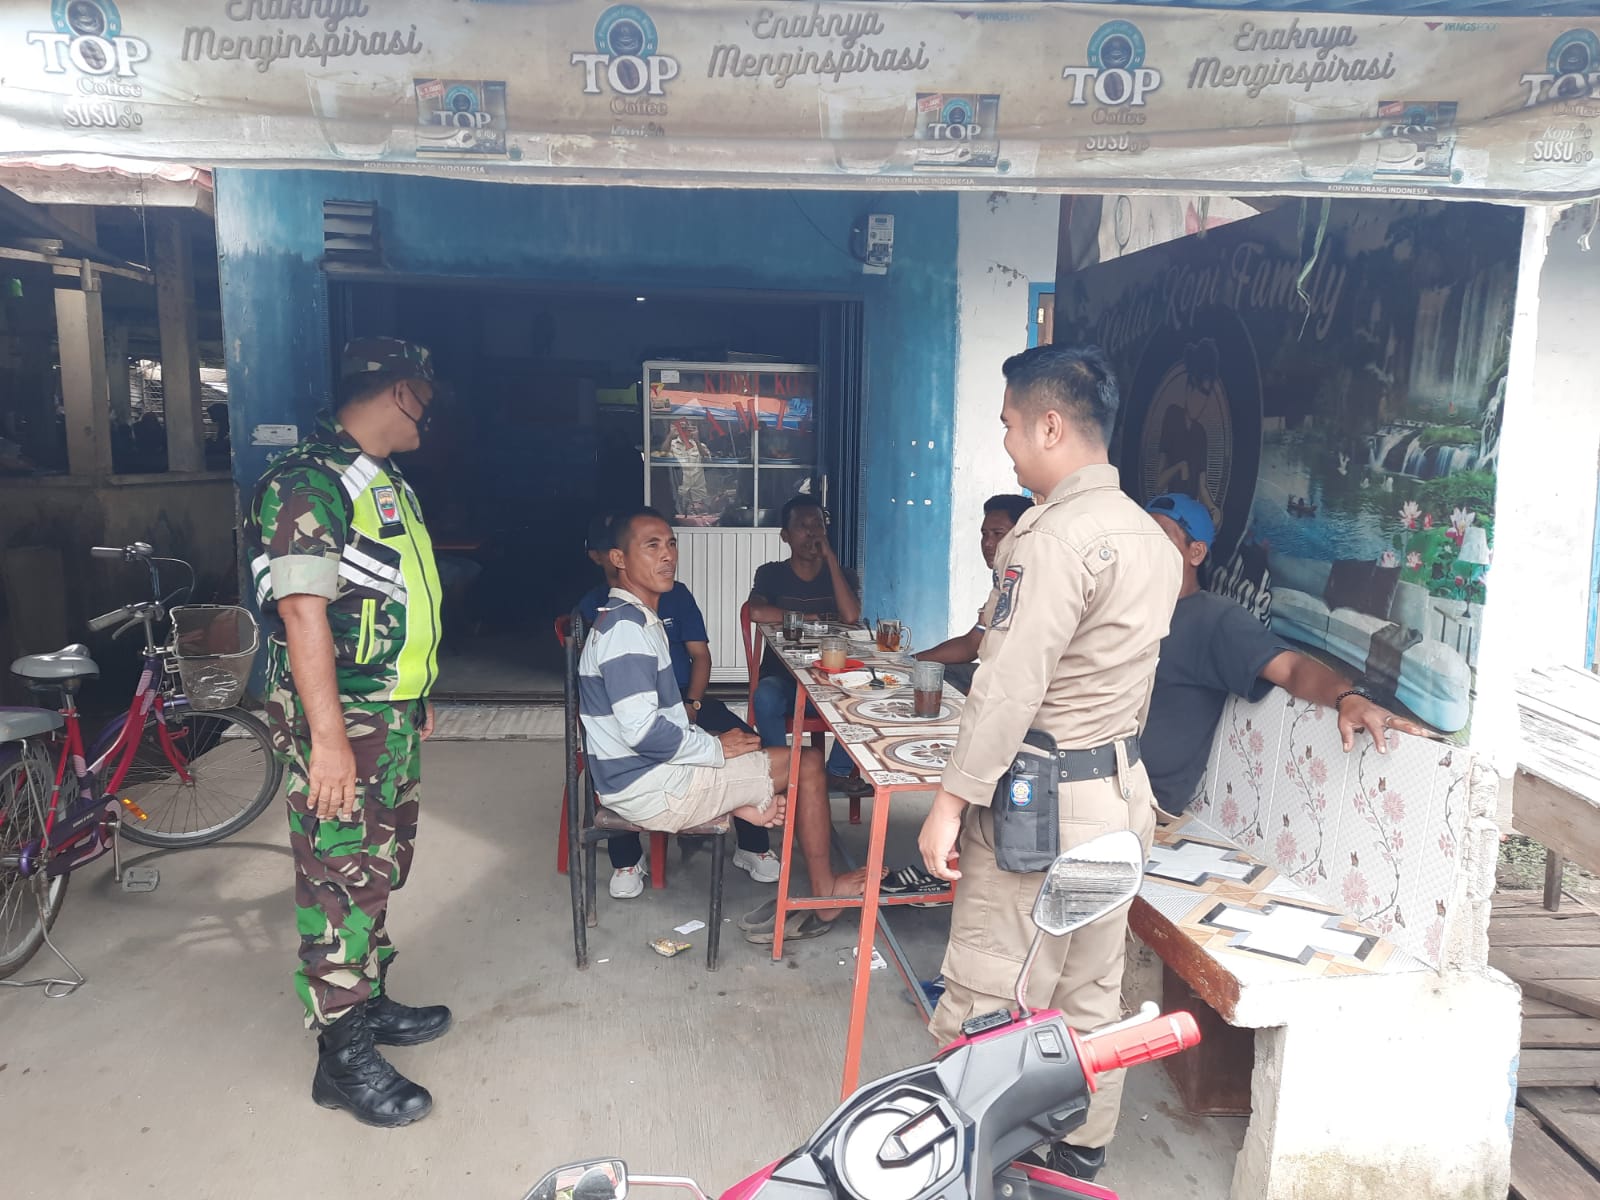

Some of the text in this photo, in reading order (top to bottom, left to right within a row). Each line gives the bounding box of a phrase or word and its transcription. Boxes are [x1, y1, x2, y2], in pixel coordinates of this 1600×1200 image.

[751, 2, 884, 48] Enaknya
[1233, 17, 1358, 60] Enaknya
[27, 31, 151, 77] TOP
[181, 24, 423, 73] Menginspirasi
[707, 41, 929, 88] Menginspirasi
[77, 77, 142, 97] Coffee
[571, 53, 680, 95] TOP
[1062, 67, 1161, 105] TOP
[1187, 52, 1396, 98] Menginspirasi
[432, 110, 491, 128] TOP
[610, 96, 667, 115] Coffee
[928, 123, 982, 140] TOP
[1543, 126, 1577, 140] Kopi
[1533, 141, 1574, 161] SUSU
[1328, 184, 1428, 195] KOPINYA ORANG INDONESIA
